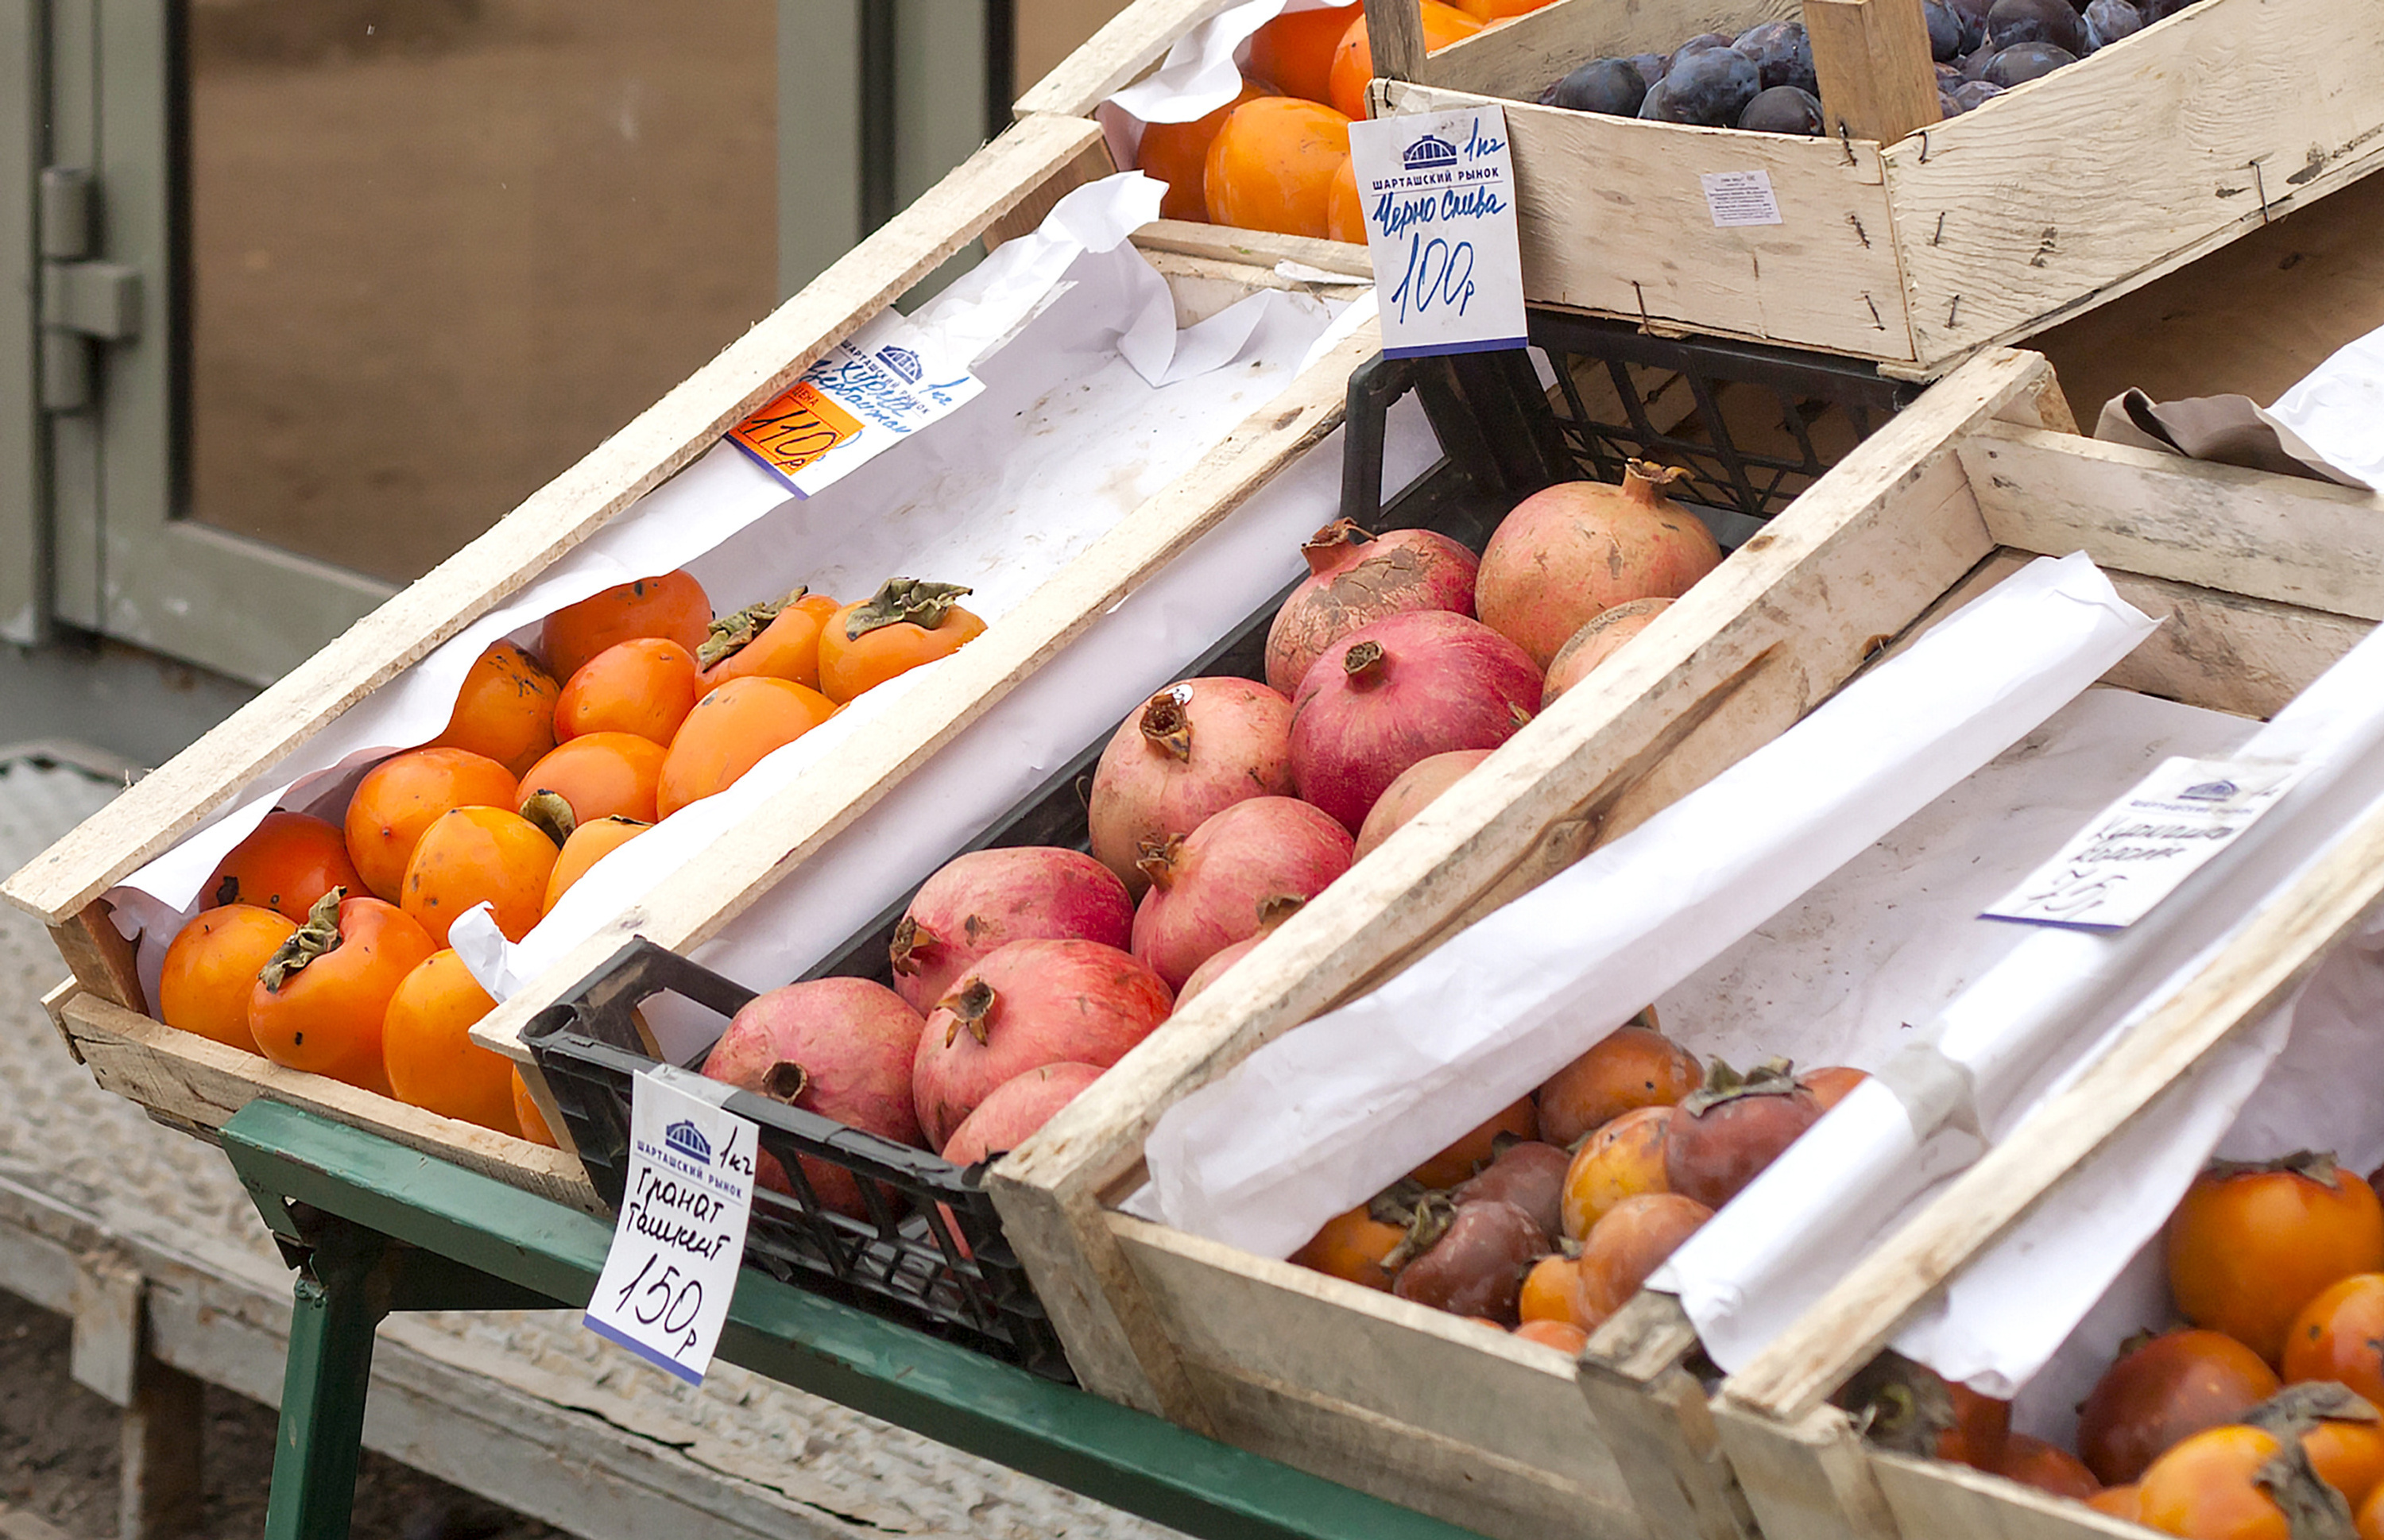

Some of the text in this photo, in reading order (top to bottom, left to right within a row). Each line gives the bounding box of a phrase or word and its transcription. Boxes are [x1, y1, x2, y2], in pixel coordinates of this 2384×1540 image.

[1372, 166, 1500, 190] ШАРТАШСКИЙ РЫНОК
[792, 385, 819, 408] ЦЕНА
[841, 339, 931, 415] ШАРТАШСКИЙ РЫНОК
[637, 1140, 742, 1199] ШАРТАШСКИЙ РЫНОК
